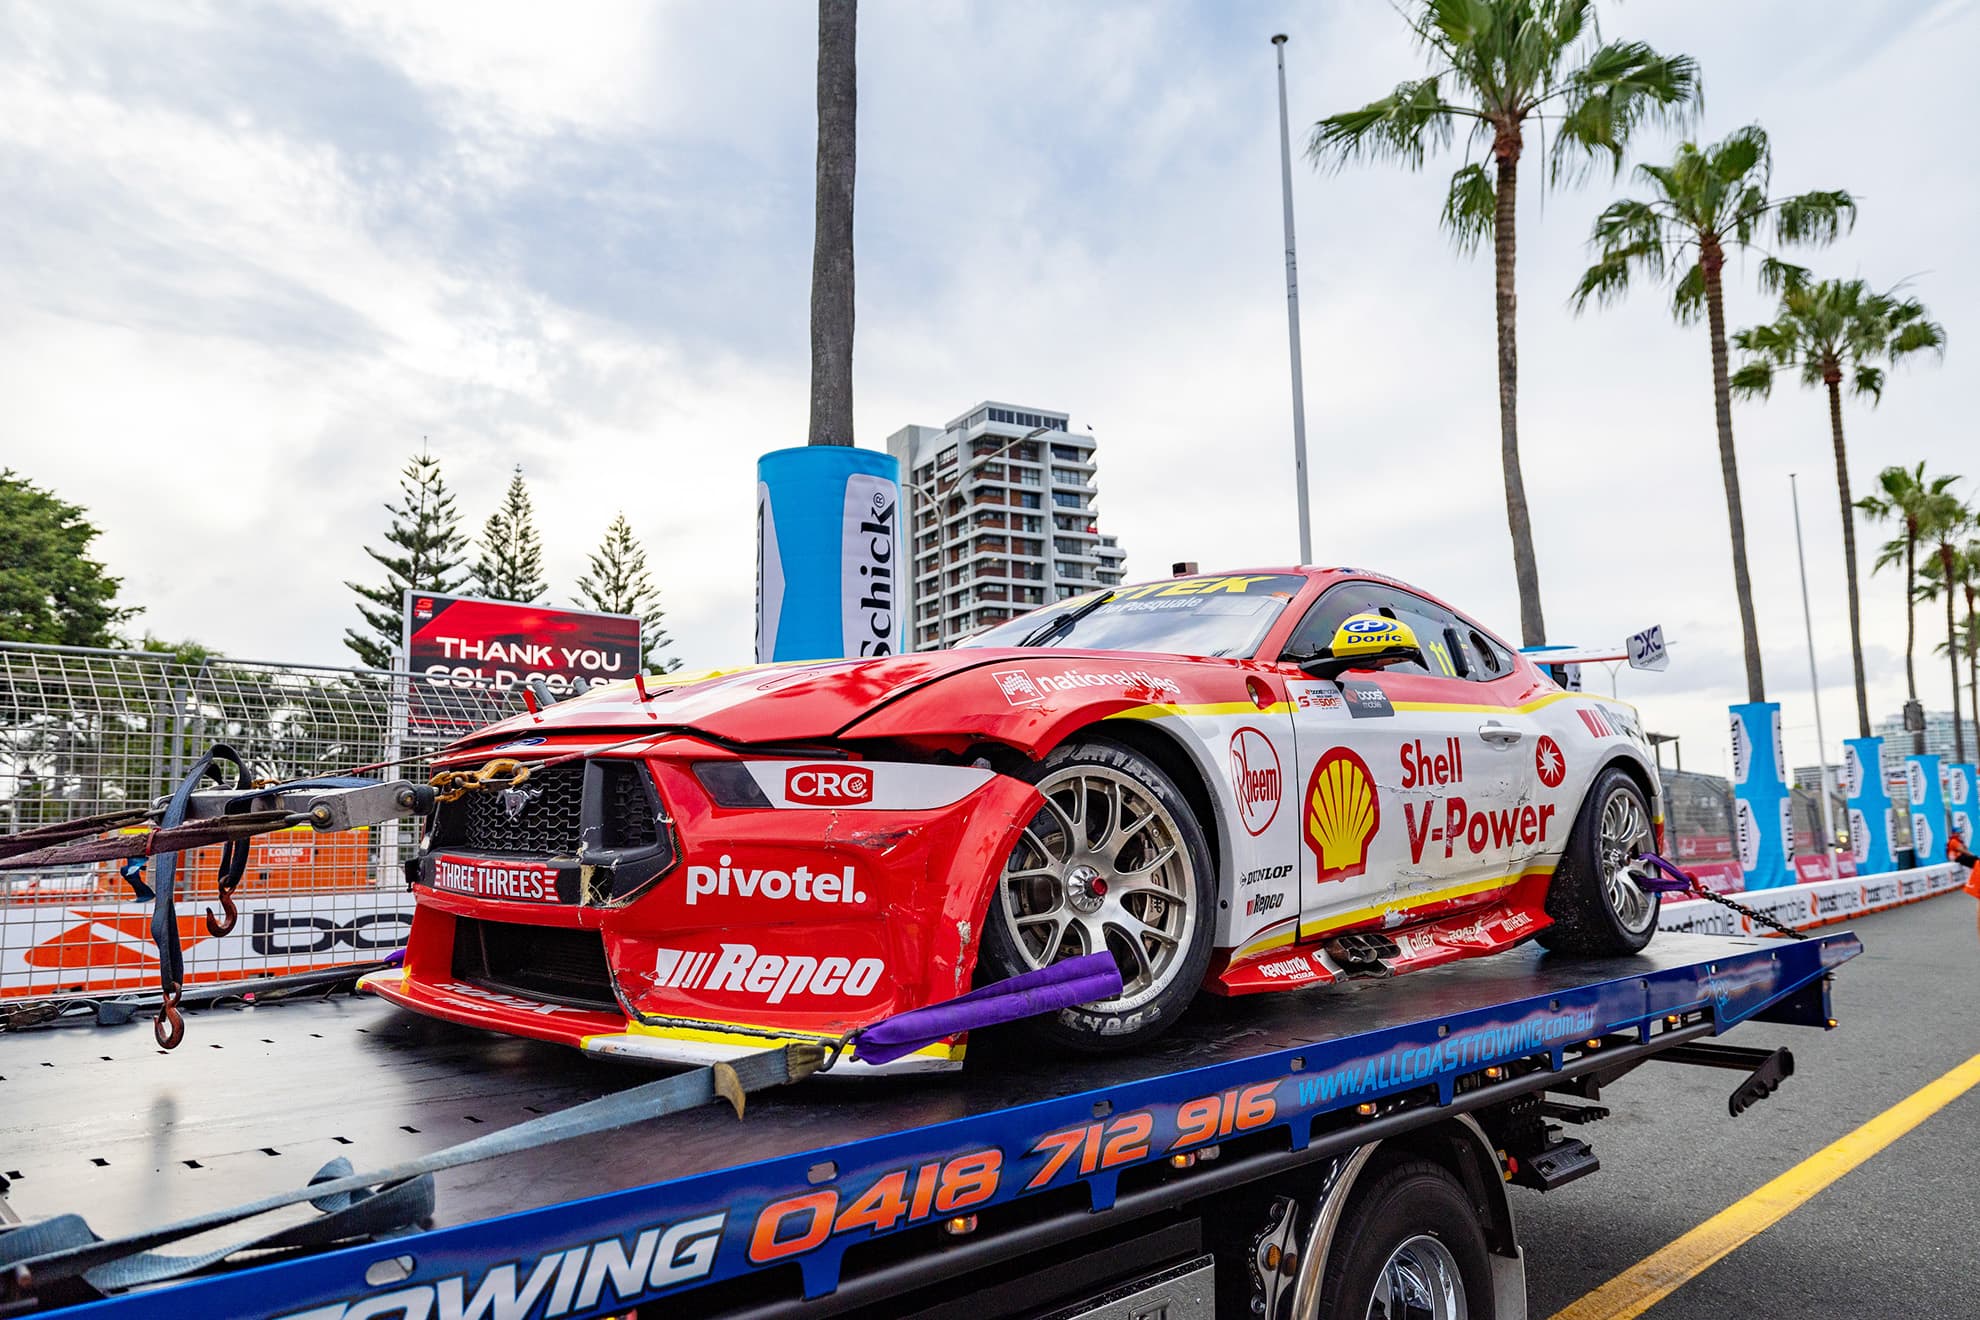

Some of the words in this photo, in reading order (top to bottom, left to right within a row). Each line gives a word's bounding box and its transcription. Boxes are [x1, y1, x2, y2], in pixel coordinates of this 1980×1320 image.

[1121, 597, 1204, 613] Pasquale
[436, 636, 554, 667] THANK
[561, 648, 621, 672] YOU
[1347, 633, 1402, 644] Doric
[1634, 626, 1662, 660] DXC
[1429, 641, 1457, 677] 11
[1355, 688, 1387, 701] boost
[1232, 731, 1278, 817] Rheem
[1400, 736, 1463, 789] Shell
[790, 771, 868, 799] CRC
[1403, 797, 1555, 865] V-Power
[442, 862, 475, 892] THREE
[477, 867, 544, 899] THREES
[686, 855, 867, 905] pivotel.
[1246, 864, 1293, 886] DUNLOP
[1252, 892, 1284, 916] Repco
[703, 943, 885, 1004] Repco
[748, 1149, 1003, 1263] 0418
[1028, 1112, 1152, 1190] 712
[1172, 1079, 1284, 1151] 916
